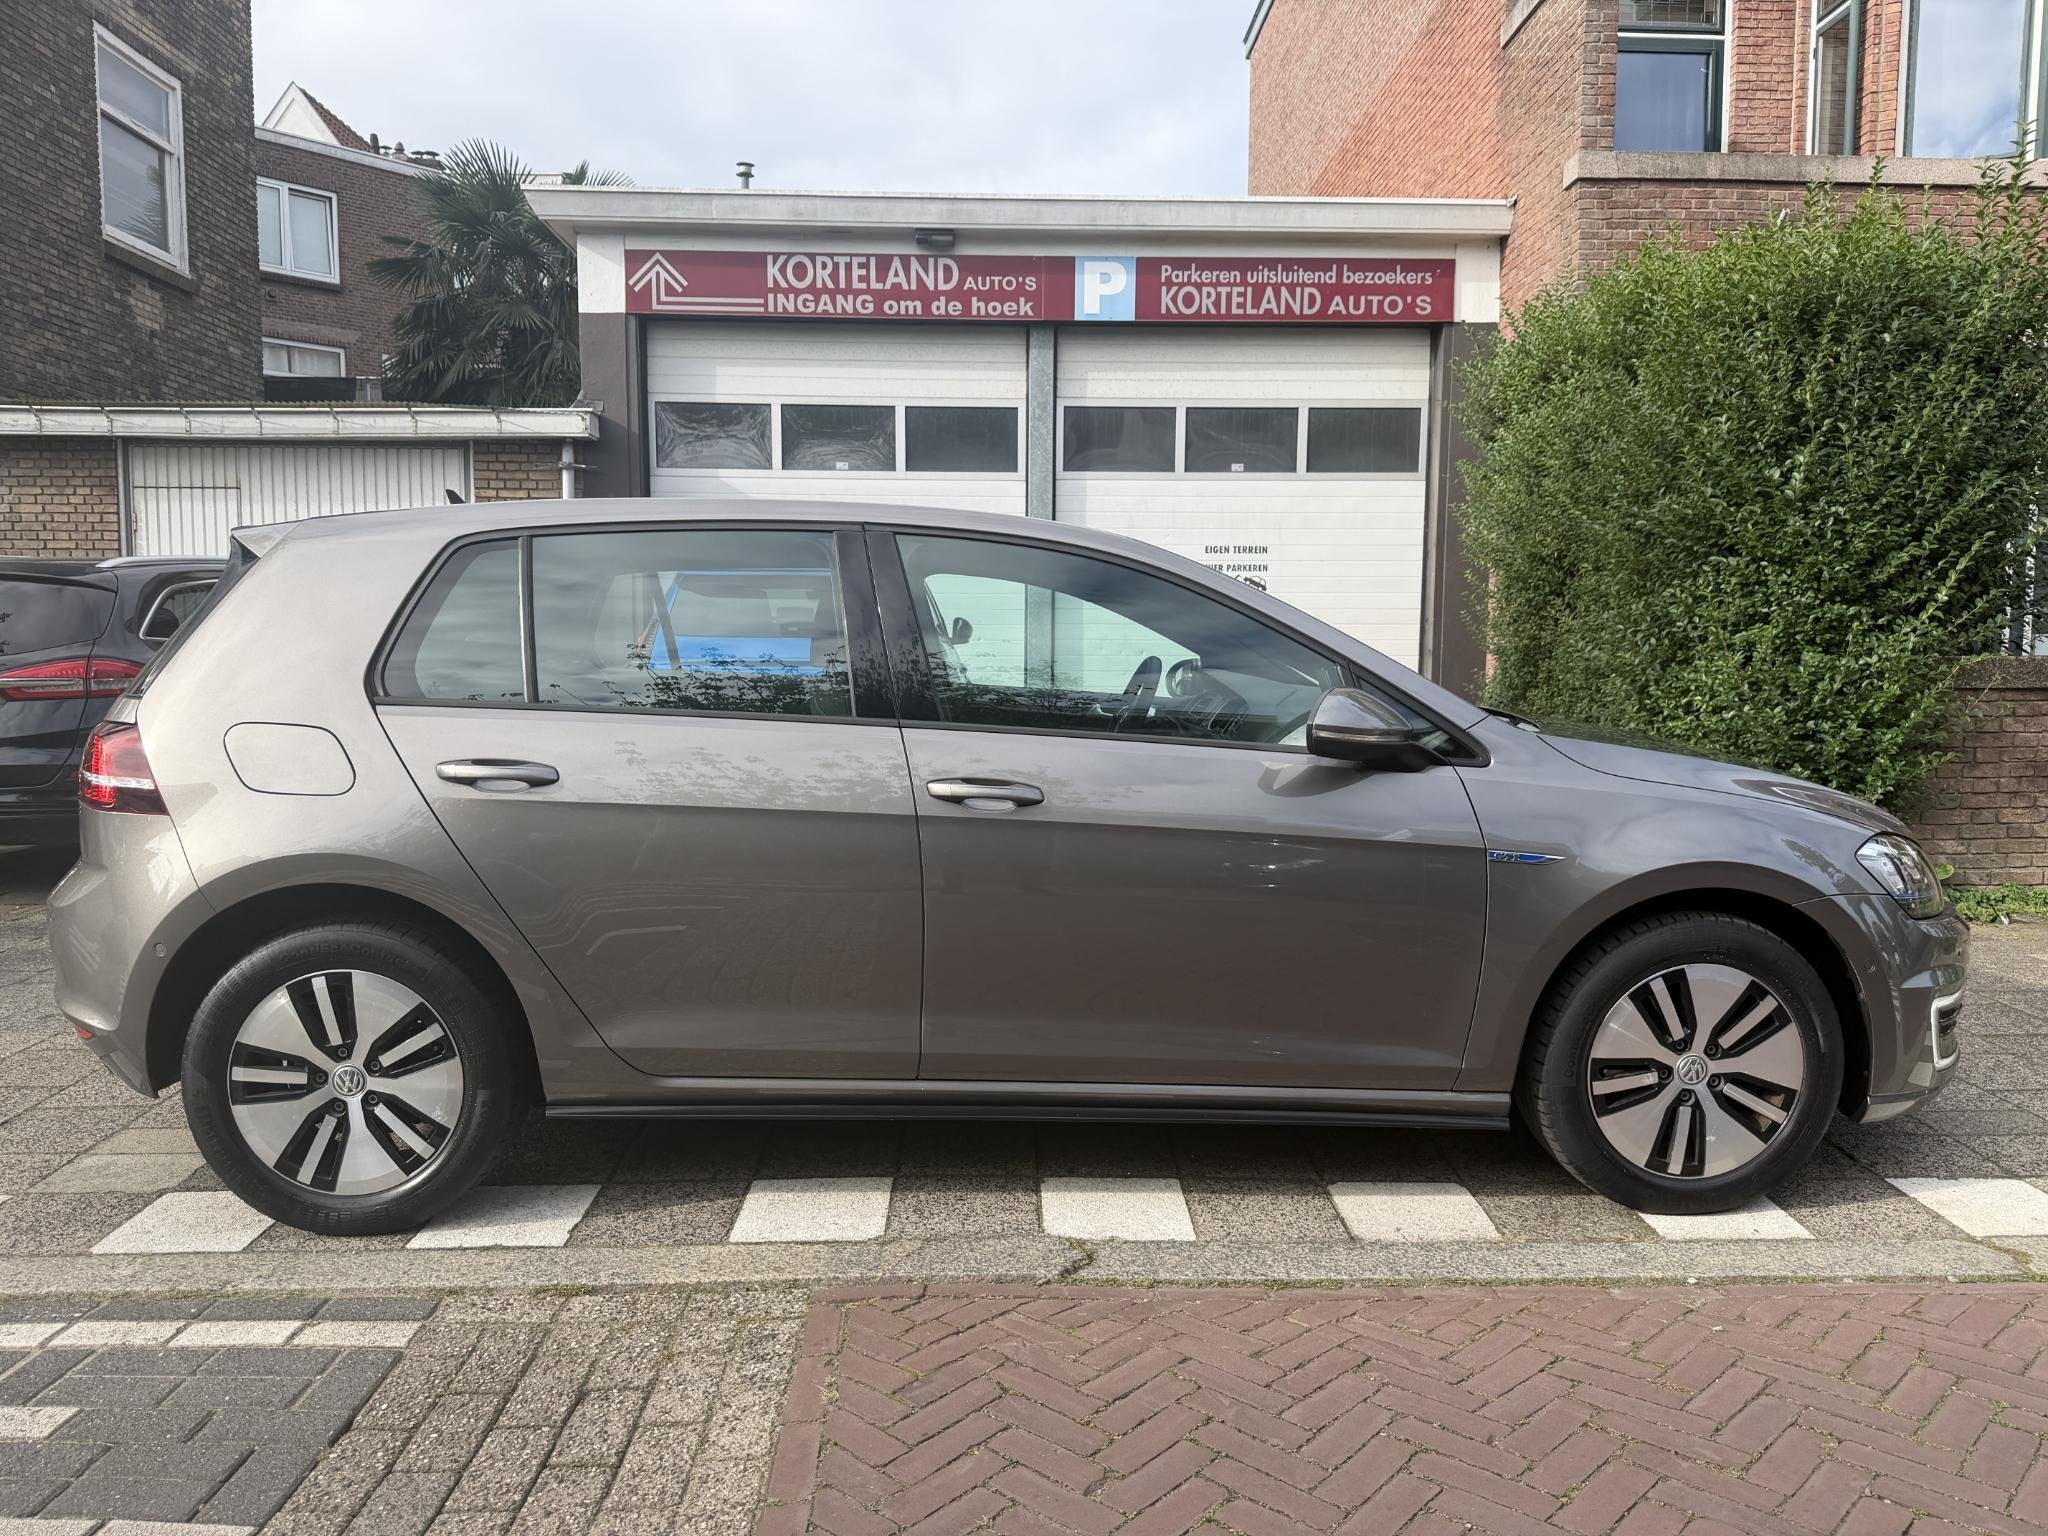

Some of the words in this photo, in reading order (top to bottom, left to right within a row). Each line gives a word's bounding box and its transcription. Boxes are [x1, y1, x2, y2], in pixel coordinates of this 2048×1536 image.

[766, 254, 960, 291] KORTELAND
[963, 276, 1037, 291] AUTO'S
[1160, 263, 1240, 283] Parkeren
[1247, 264, 1337, 284] uitsluitend
[1342, 264, 1433, 285] bezoekers
[1083, 261, 1127, 315] P
[767, 292, 874, 314] INGANG
[883, 299, 922, 315] om
[931, 296, 963, 316] de
[971, 296, 1035, 316] hoek
[1160, 285, 1322, 316] KORTELAND
[1327, 295, 1433, 315] AUTO'S
[1205, 545, 1230, 554] EIGEN
[1233, 545, 1268, 554] TERREIN
[1226, 564, 1268, 572] PARKEREN
